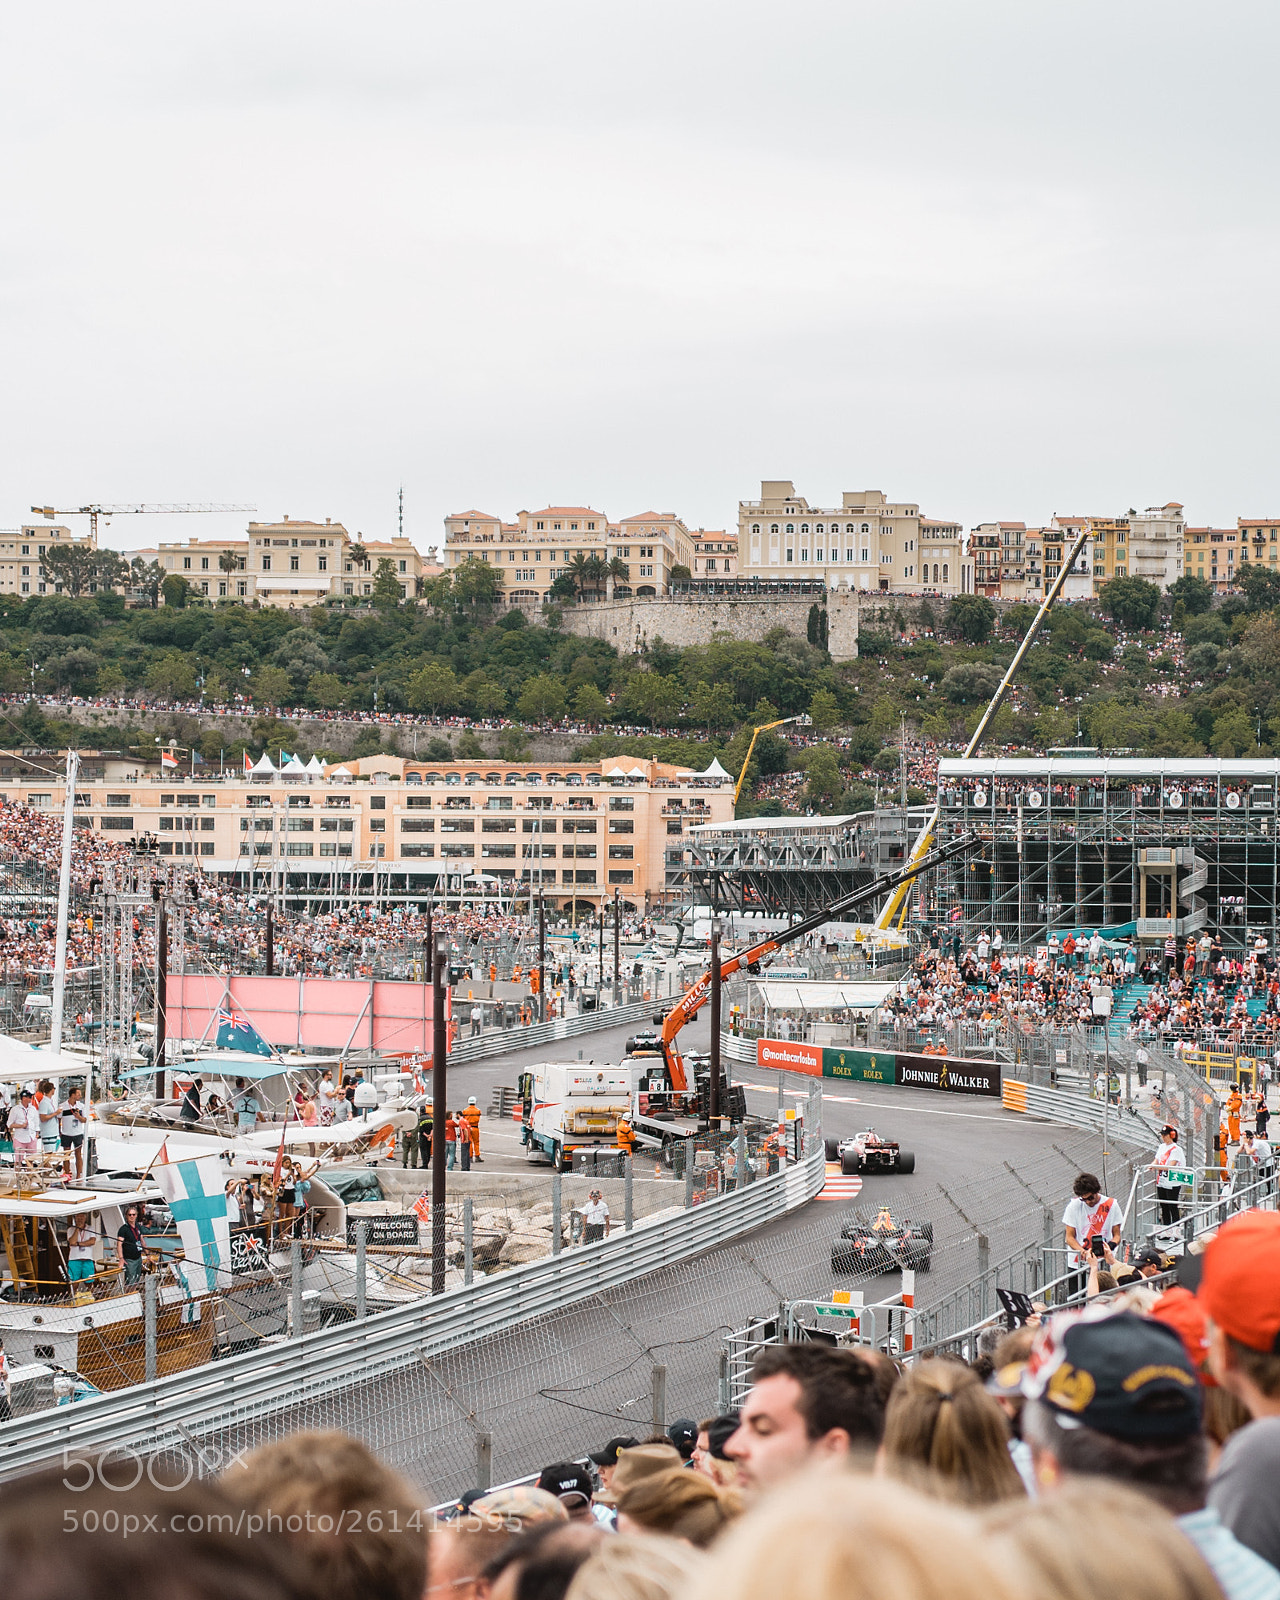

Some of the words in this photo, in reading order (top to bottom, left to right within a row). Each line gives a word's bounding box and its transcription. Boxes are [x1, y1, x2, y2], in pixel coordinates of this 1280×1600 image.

[762, 1047, 817, 1067] @montecarlosbm
[832, 1066, 852, 1076] ROLEX
[863, 1069, 884, 1080] ROLEX
[901, 1066, 939, 1084] JOHNNIE
[948, 1072, 990, 1089] WALKER
[373, 1221, 414, 1230] WELCOME
[373, 1231, 385, 1239] ON
[386, 1231, 414, 1239] BOARD
